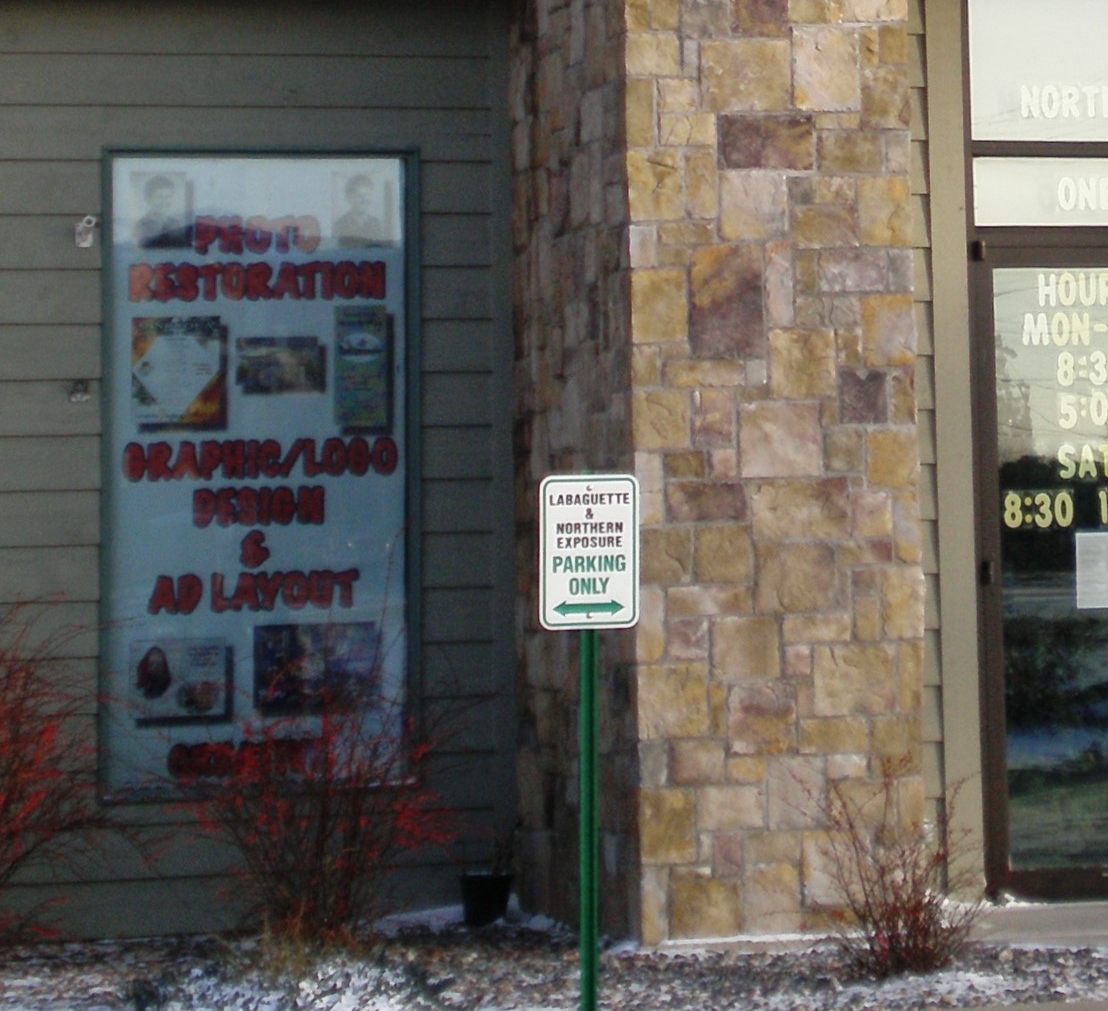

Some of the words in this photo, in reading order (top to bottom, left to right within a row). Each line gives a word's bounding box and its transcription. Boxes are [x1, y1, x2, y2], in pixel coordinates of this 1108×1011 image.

[195, 214, 320, 255] PHOTO
[128, 261, 387, 302] RESTORATION
[193, 485, 325, 528] DESIGN
[549, 492, 630, 506] LABAGUETTE
[585, 508, 594, 520] &
[1004, 490, 1074, 529] 8:30
[556, 522, 623, 535] NORTHERN
[557, 536, 623, 549] EXPOSURE
[552, 554, 626, 573] PARKING
[148, 574, 203, 615] AD
[211, 568, 360, 614] LAYOUT
[569, 577, 610, 595] ONLY
